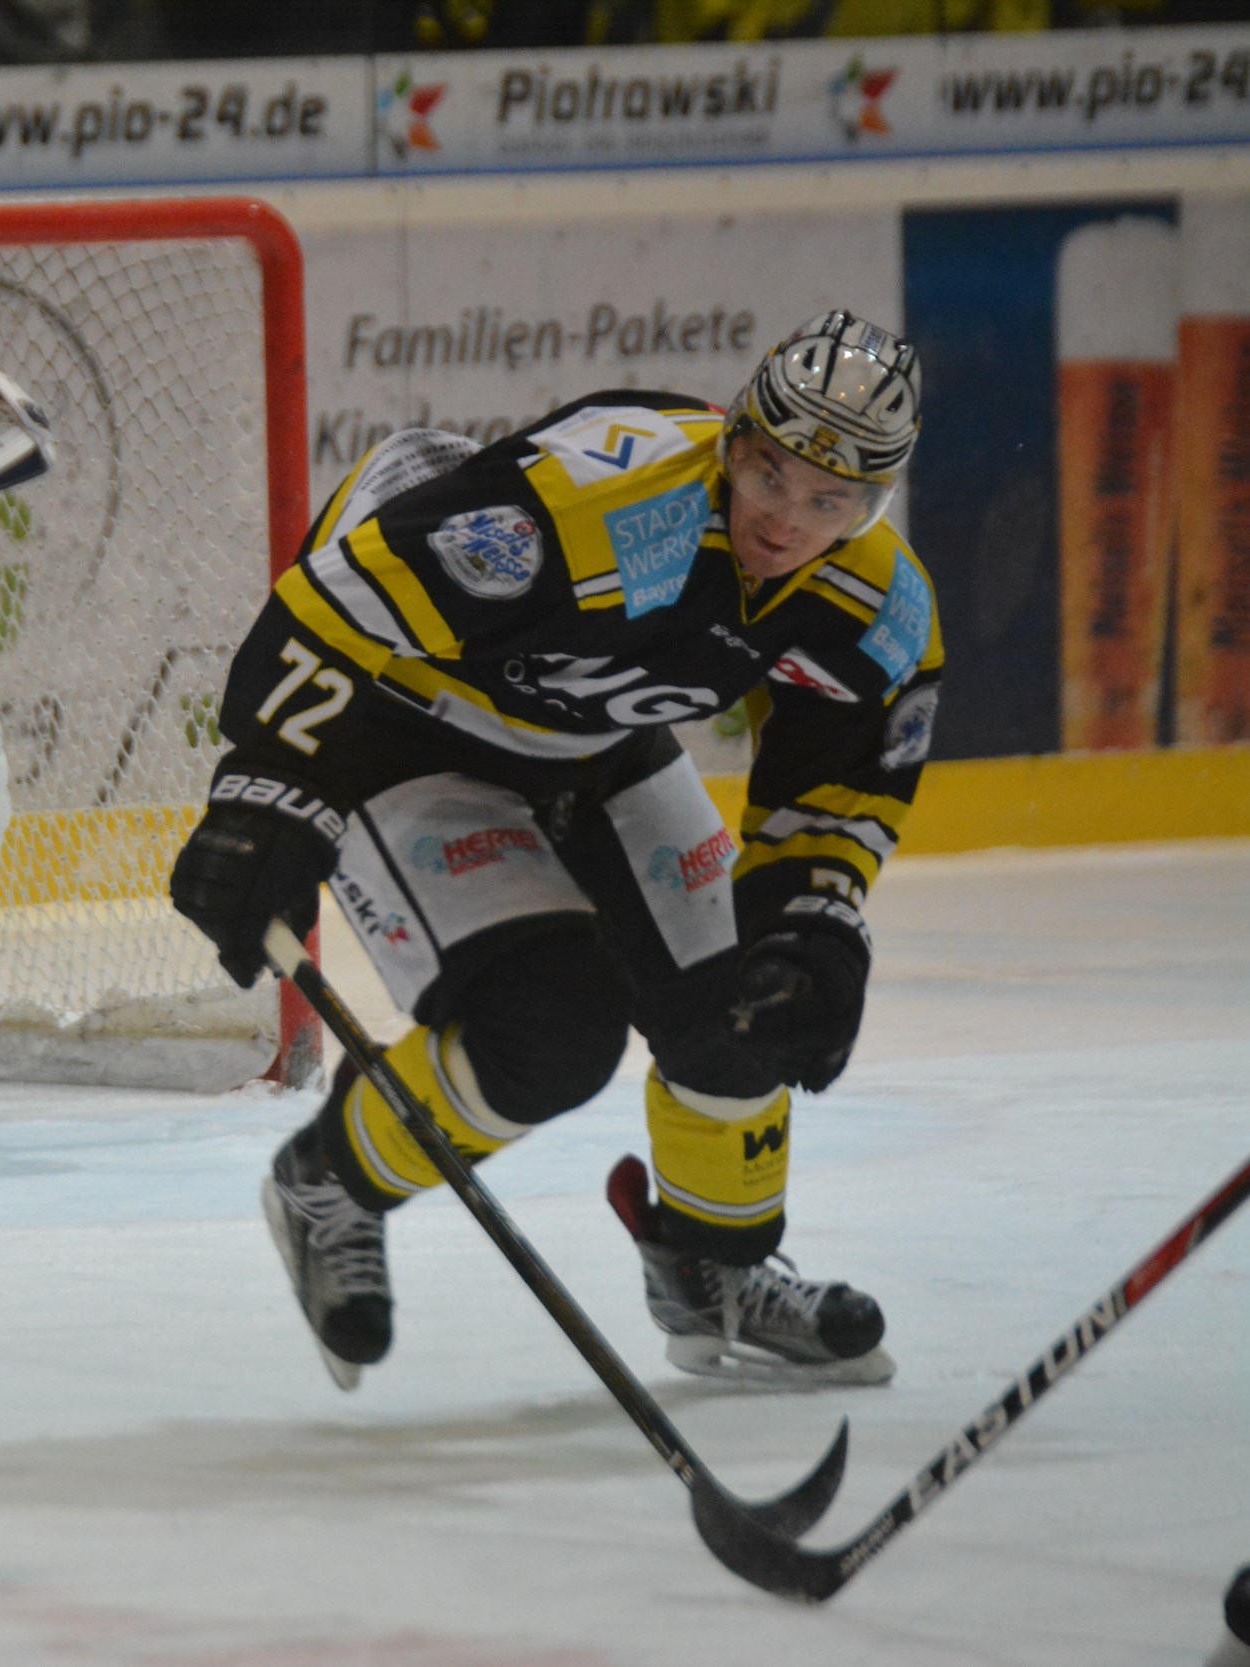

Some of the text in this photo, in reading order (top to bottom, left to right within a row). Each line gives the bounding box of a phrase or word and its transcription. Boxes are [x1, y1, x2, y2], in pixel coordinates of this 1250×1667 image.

[497, 57, 780, 123] Piotrowski
[345, 300, 755, 368] Familien-Pakete
[615, 490, 702, 549] STADT
[256, 636, 354, 757] 72
[907, 1284, 1126, 1514] EASTON
